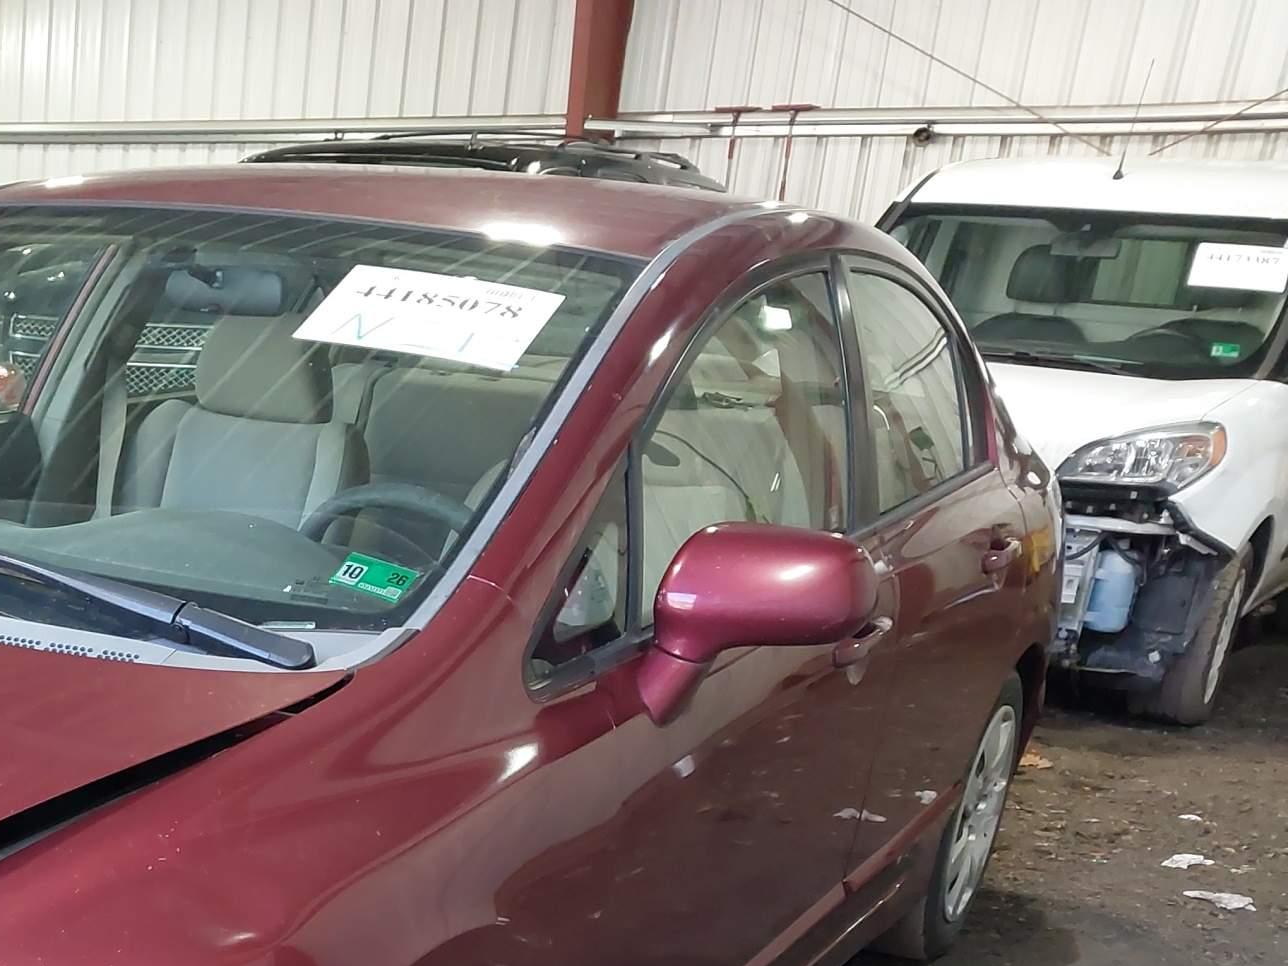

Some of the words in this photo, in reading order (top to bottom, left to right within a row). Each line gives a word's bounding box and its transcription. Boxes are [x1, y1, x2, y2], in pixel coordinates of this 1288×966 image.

[356, 285, 523, 319] 44185078
[341, 564, 365, 580] 10
[387, 572, 410, 587] 26
